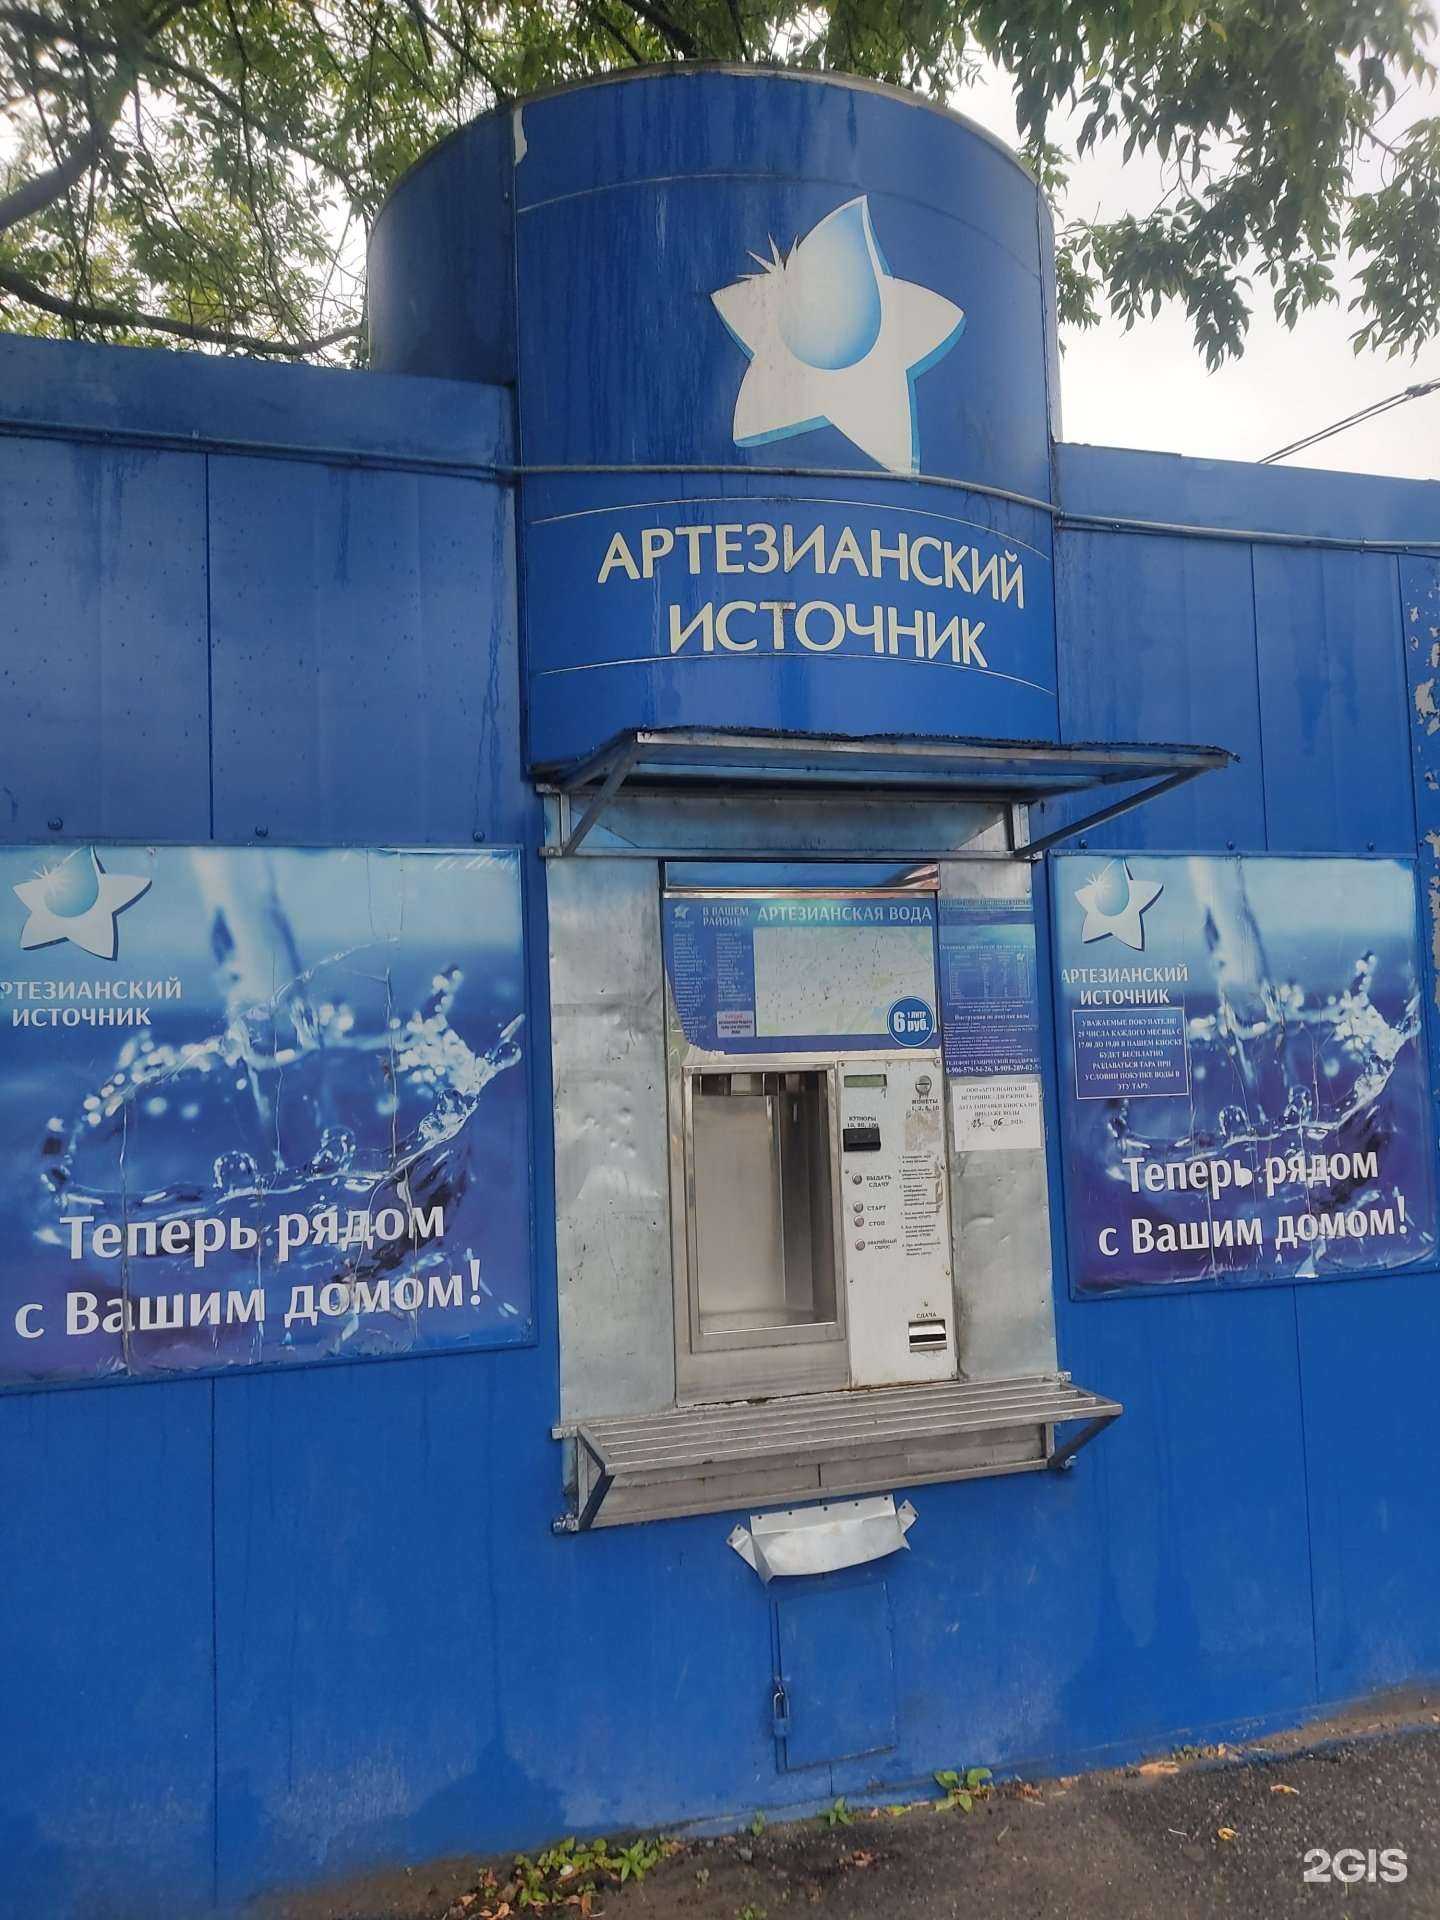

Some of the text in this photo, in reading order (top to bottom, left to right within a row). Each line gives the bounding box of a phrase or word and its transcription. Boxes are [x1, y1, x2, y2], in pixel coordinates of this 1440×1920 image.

[597, 522, 1025, 609] АРТЕЗИАНСКИЙ
[669, 600, 988, 668] ИСТОЧНИК
[757, 905, 932, 923] АРТЕЗИАНСКАЯ ВОДА
[1061, 963, 1188, 984] АРТЕЗИАНСКИЙ
[0, 976, 182, 1000] РТЕЗИАНСКИЙ
[1080, 988, 1170, 1006] ИСТОЧНИК
[12, 1007, 152, 1027] ИСТОЧНИК
[894, 1011, 906, 1032] 6
[1082, 1019, 1127, 1027] УВАЖАЕМЫЕ
[1111, 1028, 1146, 1037] КАЖДОГО
[1122, 1050, 1164, 1058] БЕСПЛАТНО
[1122, 1151, 1379, 1200] Теперь рядом
[1098, 1195, 1408, 1256] с Вашим домом!
[60, 1206, 445, 1268] Теперь рядом
[14, 1258, 482, 1339] с Вашим домом!
